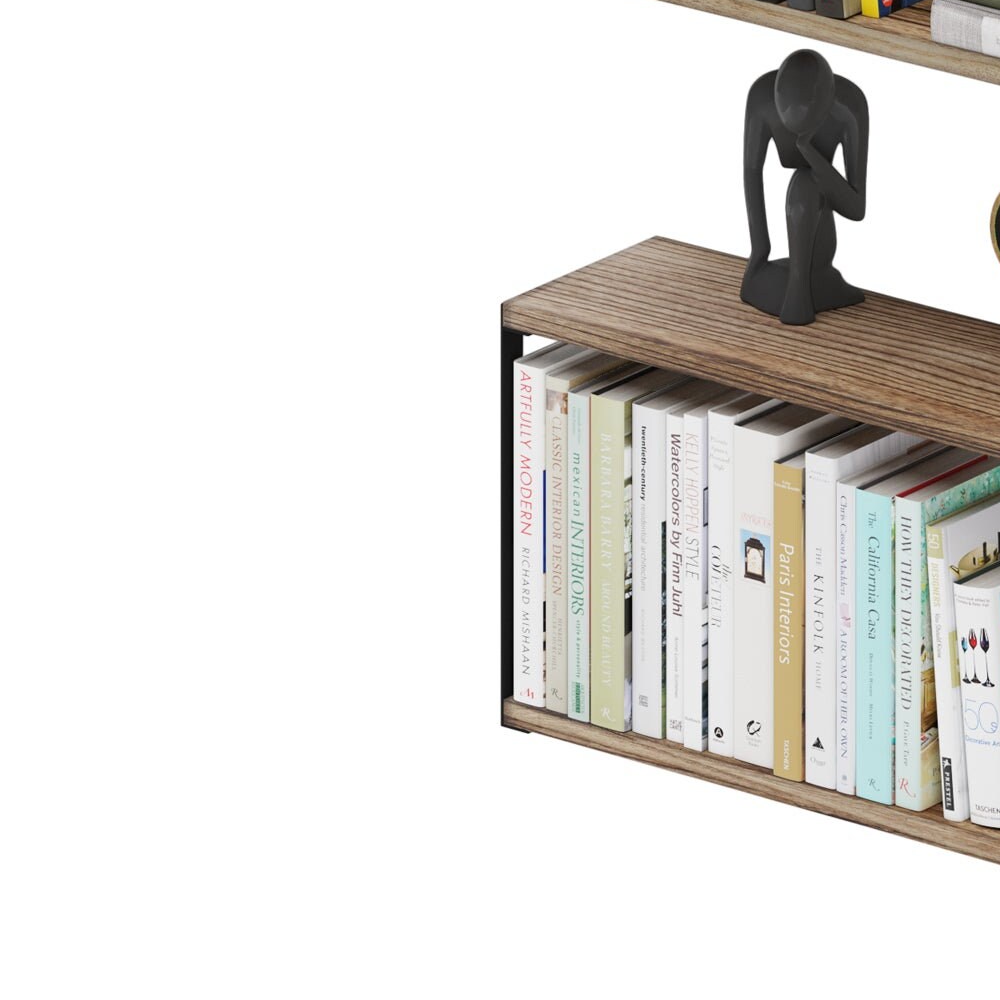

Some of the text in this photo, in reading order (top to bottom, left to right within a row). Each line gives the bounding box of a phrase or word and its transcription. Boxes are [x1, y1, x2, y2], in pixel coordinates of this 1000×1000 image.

[551, 416, 562, 596] CLASSIC INTERIOR DESIGN
[572, 452, 582, 517] mexican
[685, 432, 699, 580] KELLY HOPPEN STYLE
[519, 370, 533, 675] ARTFULLY MODERN RICHARD MISHAAN
[670, 433, 683, 617] Watercolors by Finn Juhl
[867, 511, 877, 529] The
[927, 532, 940, 550] 50
[570, 520, 585, 616] INTERIORS
[867, 536, 881, 604] California
[930, 561, 941, 608] DESIGNERS
[778, 542, 795, 665] Paris Interiors
[813, 573, 824, 654] KINFOLK
[867, 608, 880, 640] Casa
[900, 516, 912, 711] HOW THEY DECORATED
[840, 640, 848, 679] ROOM
[840, 699, 848, 724] HER
[840, 728, 848, 759] OWN
[964, 698, 999, 734] 50s
[943, 771, 952, 810] PRESTEL
